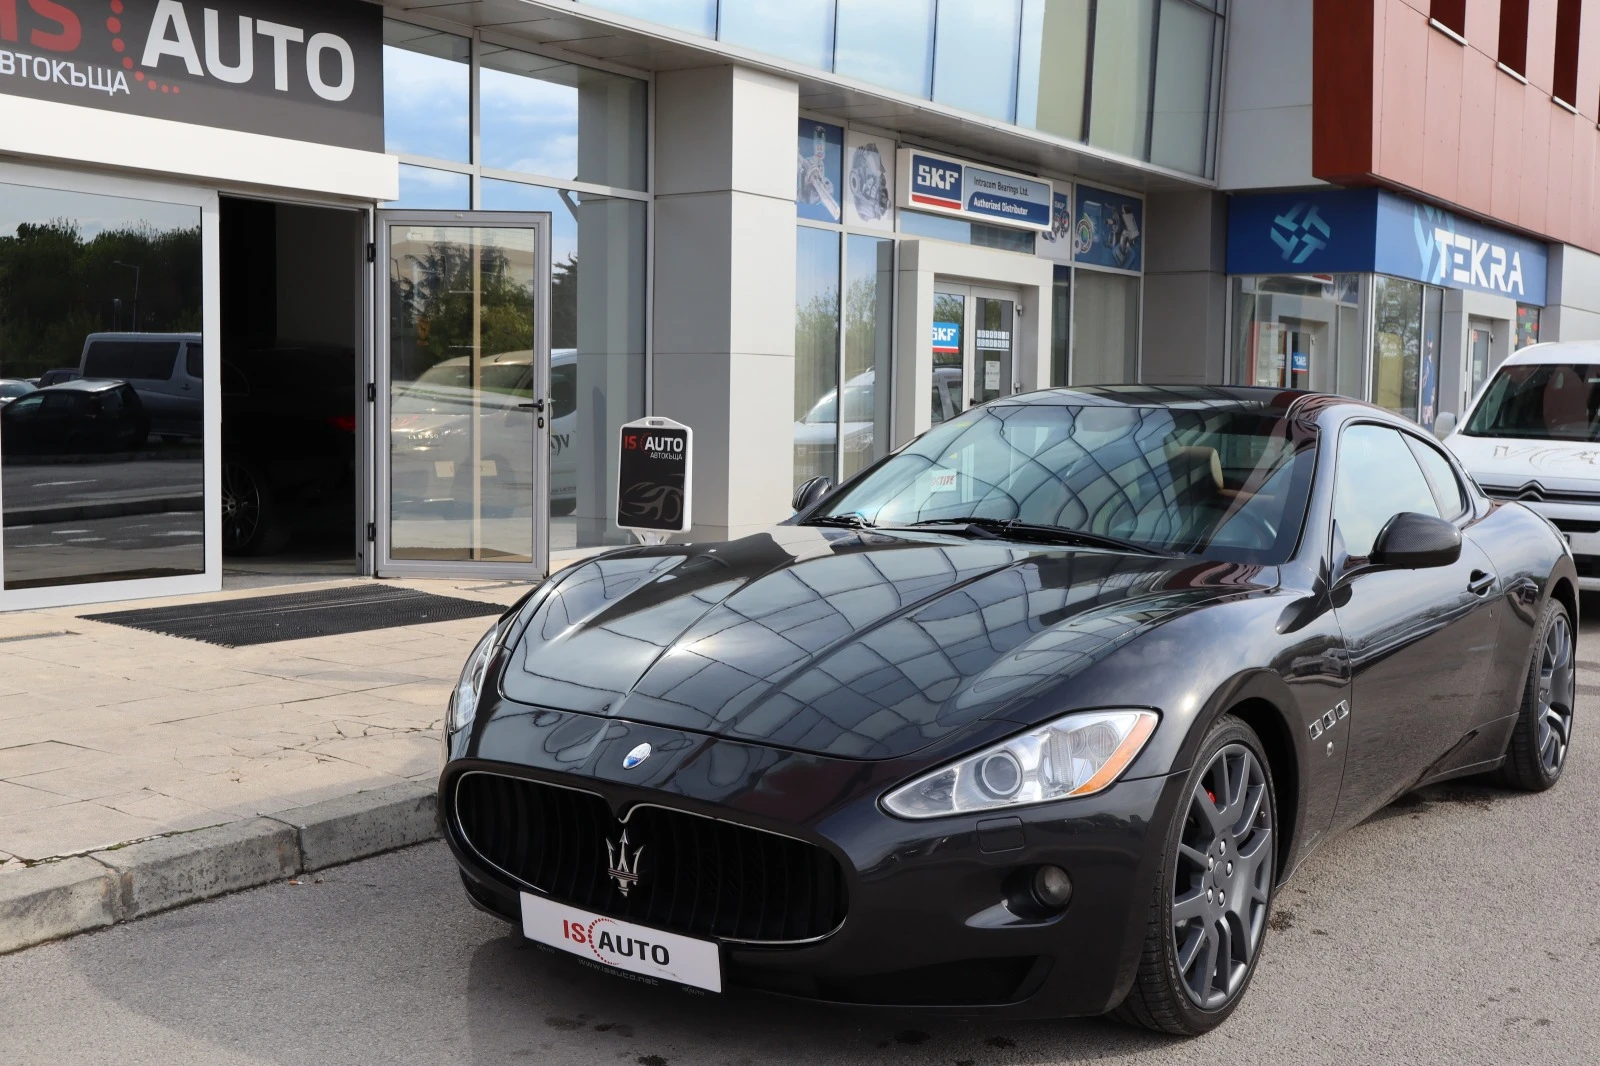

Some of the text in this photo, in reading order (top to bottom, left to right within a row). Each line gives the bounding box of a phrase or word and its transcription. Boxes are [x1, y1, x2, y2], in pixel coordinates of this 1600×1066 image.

[141, 0, 355, 101] AUTO
[917, 164, 959, 190] SKF
[973, 176, 1030, 196] Intracom Bearings Ltd.
[973, 196, 1029, 216] Authorized Distributor
[1434, 227, 1525, 296] TEKRA
[624, 435, 683, 452] IS AUTO
[650, 451, 683, 461] АВТОКЪЩА
[562, 919, 670, 966] IS AUTO
[578, 958, 659, 987] www.isauto.net
